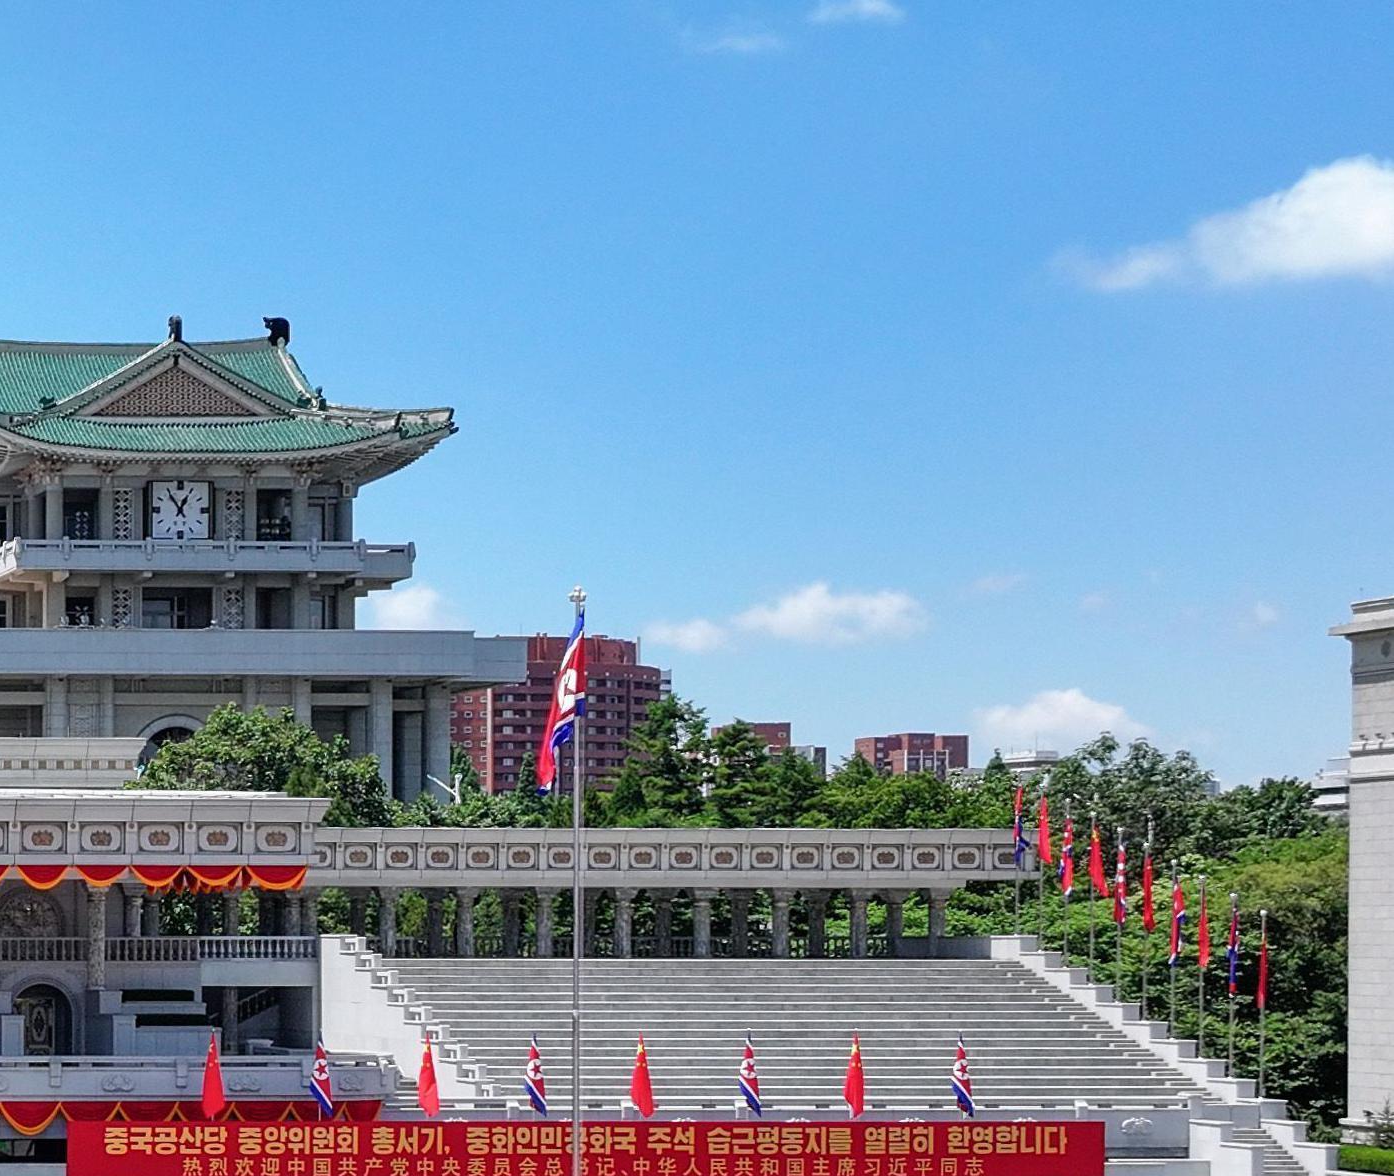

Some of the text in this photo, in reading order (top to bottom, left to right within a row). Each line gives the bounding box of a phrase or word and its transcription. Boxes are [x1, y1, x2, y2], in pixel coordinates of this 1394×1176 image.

[104, 1126, 1068, 1155] 중국공산당 중앙위원회 총서기, 중화인민공화국 주석 습근평동지를 열렬히 환영합니다
